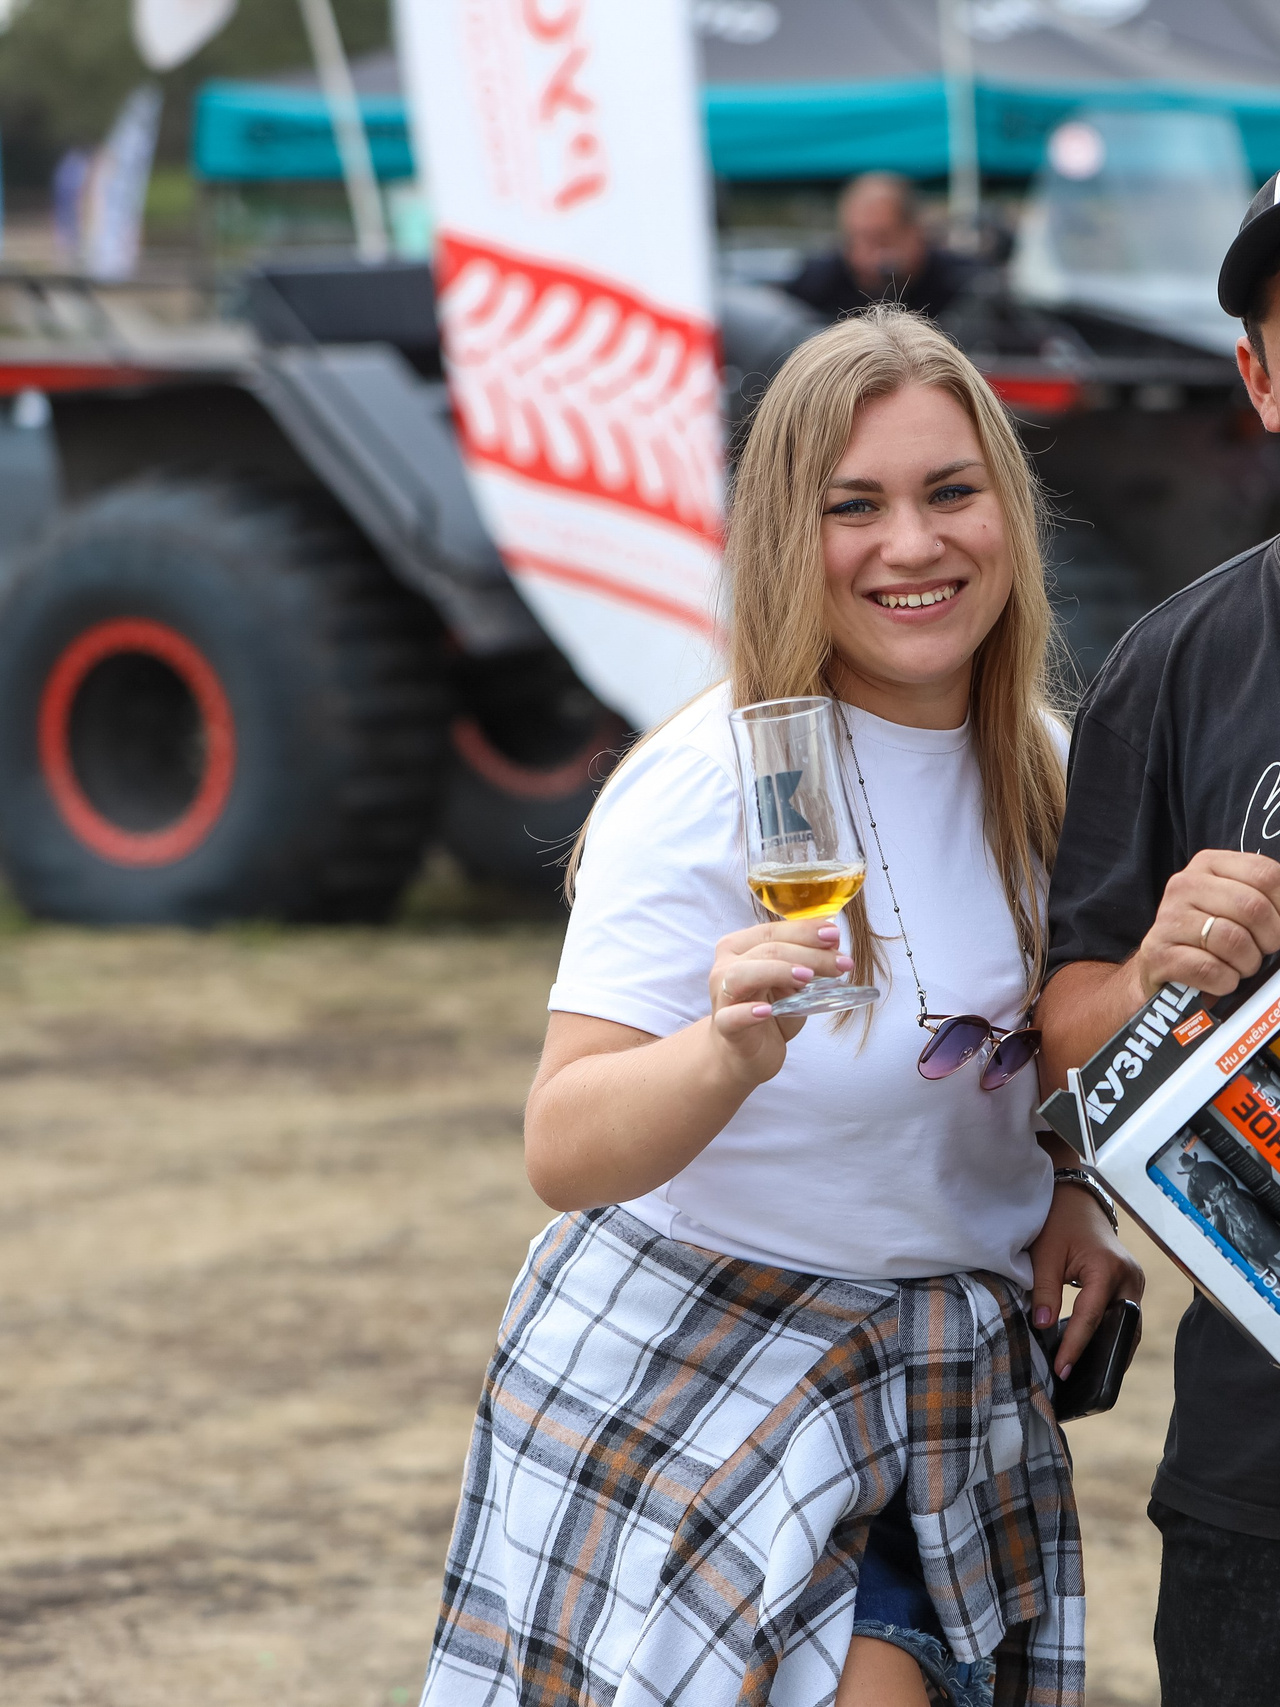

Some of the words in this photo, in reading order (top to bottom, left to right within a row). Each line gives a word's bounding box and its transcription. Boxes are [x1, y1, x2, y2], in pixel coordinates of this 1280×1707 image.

[1219, 1051, 1239, 1071] Ни
[1237, 1043, 1247, 1055] в
[1245, 1021, 1269, 1044] чём
